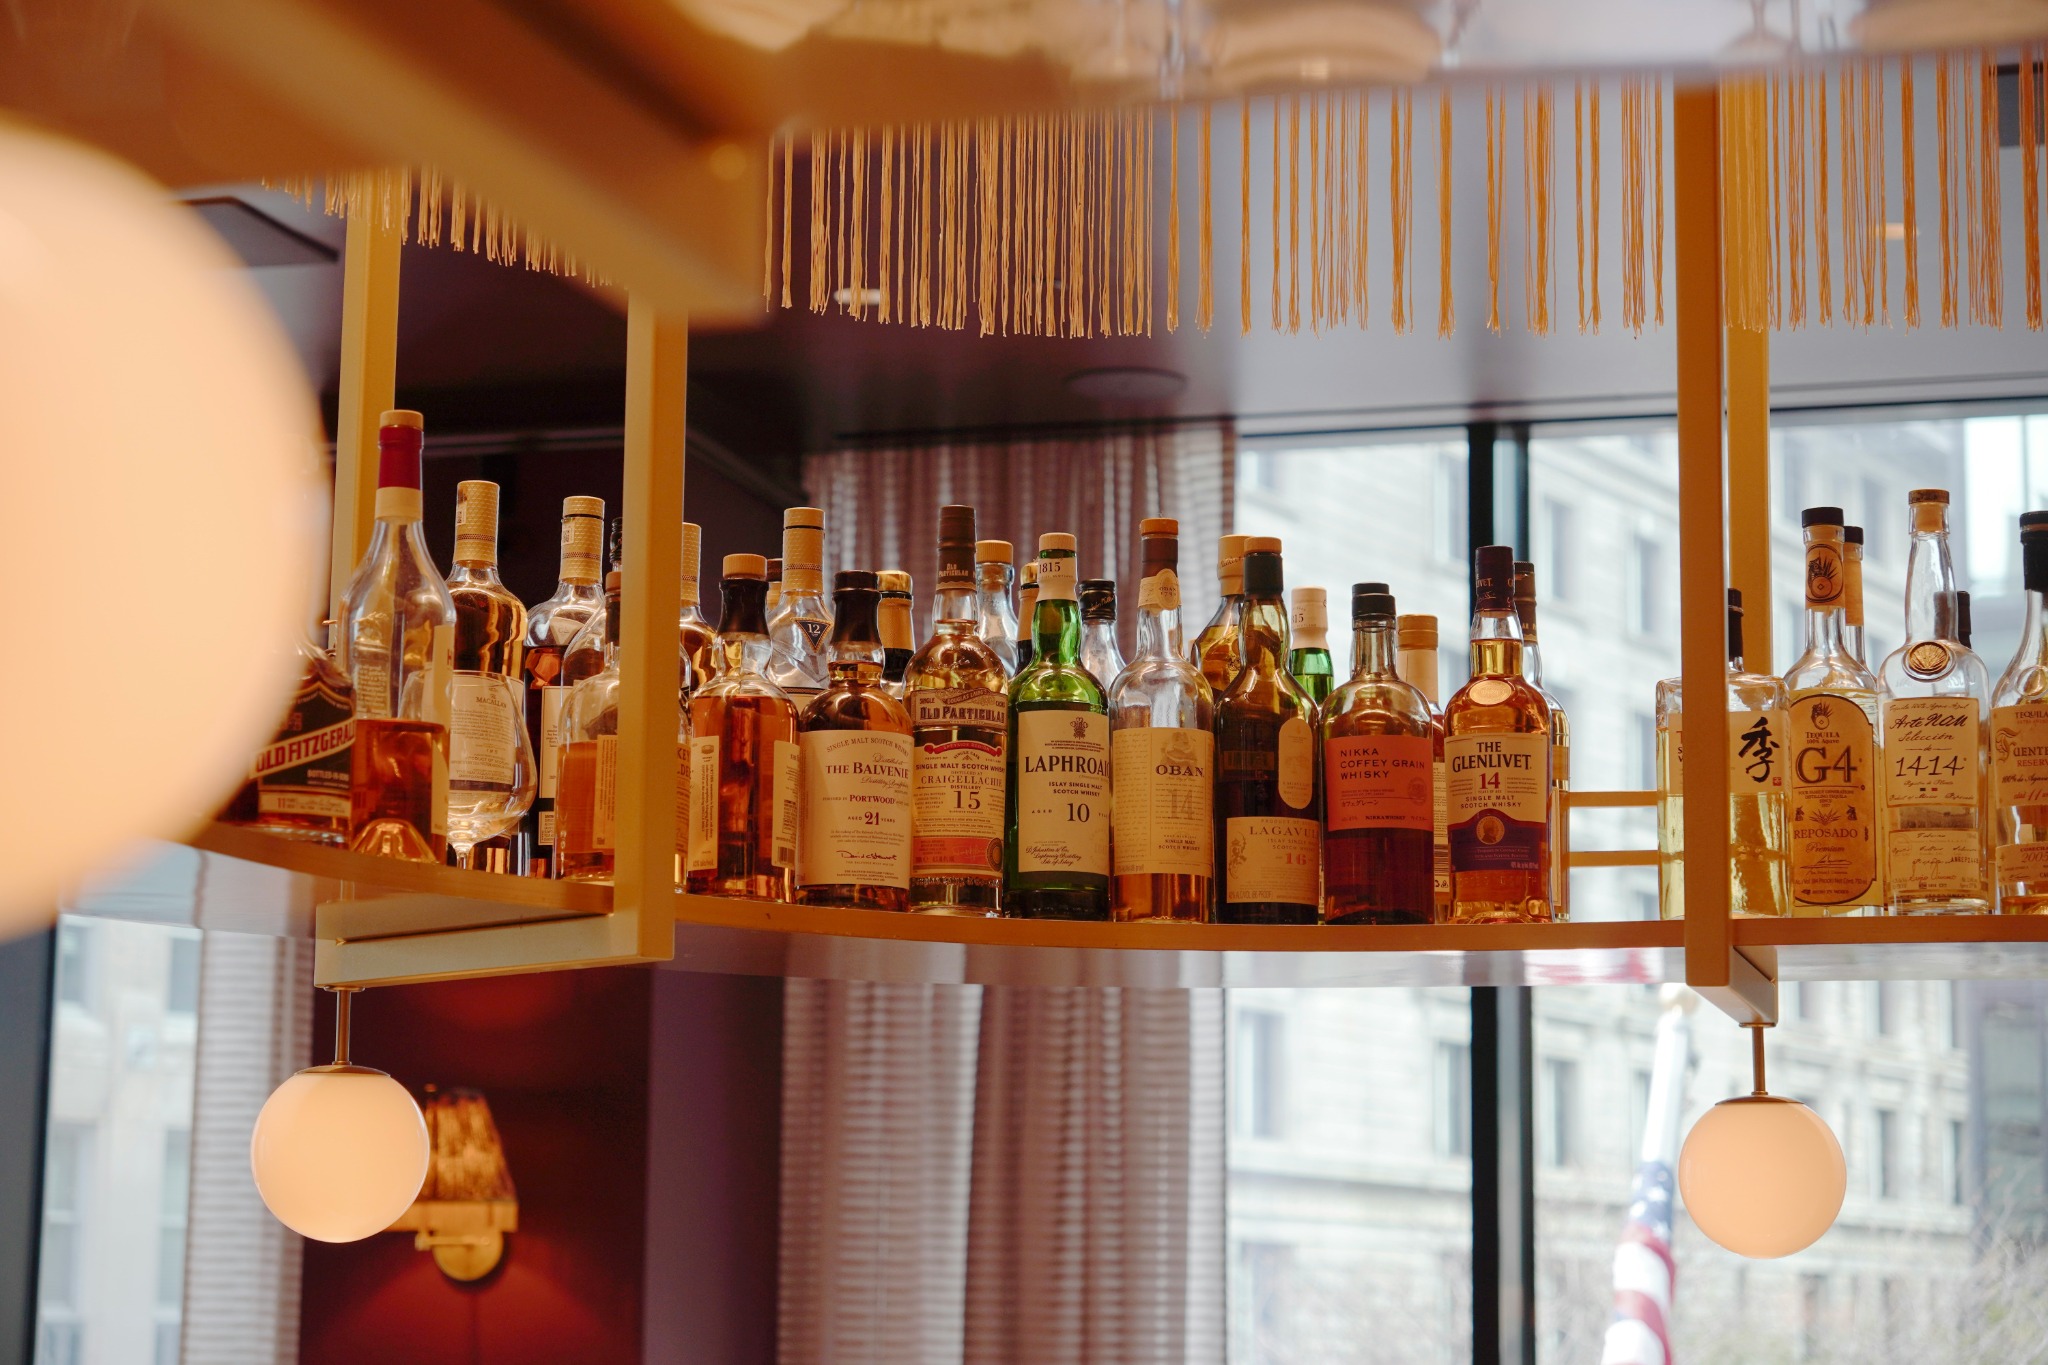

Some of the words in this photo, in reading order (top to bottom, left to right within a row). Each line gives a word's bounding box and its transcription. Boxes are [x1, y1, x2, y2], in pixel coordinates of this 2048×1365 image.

[1039, 561, 1061, 574] 1815
[807, 623, 821, 634] 12
[920, 706, 940, 720] OLD
[2015, 710, 2048, 718] TEQUILA
[1890, 714, 1924, 730] Arte
[1924, 713, 1968, 727] NOM
[1805, 732, 1840, 740] TEQUILA
[1898, 730, 1955, 742] Selección
[826, 738, 850, 753] SINGLE
[850, 737, 869, 745] MALT
[870, 737, 894, 748] SCOTCH
[1476, 741, 1502, 753] THE
[1738, 716, 1781, 784] 季
[256, 746, 286, 773] OLD
[1340, 748, 1380, 757] NIKKA
[826, 764, 850, 774] THE
[852, 761, 909, 780] BALVENIE
[916, 762, 938, 770] SINGLE
[961, 762, 989, 770] SCOTCH
[1155, 764, 1204, 778] OBAN
[1340, 759, 1388, 769] COFFEY
[1392, 759, 1425, 770] GRAIN
[1795, 744, 1858, 784] G4
[1896, 755, 1965, 777] 1414
[920, 775, 1002, 787] CRAIGELLACHIE
[1340, 770, 1390, 780] WHISKY
[1478, 772, 1501, 790] 14
[849, 794, 896, 805] PORTWOOD
[953, 790, 981, 810] 15
[1168, 788, 1194, 820] 14
[864, 810, 880, 826] 21
[1066, 802, 1090, 823] 10
[1793, 828, 1858, 840] REPOSADO
[1805, 842, 1846, 854] Premium
[1285, 852, 1308, 866] 16
